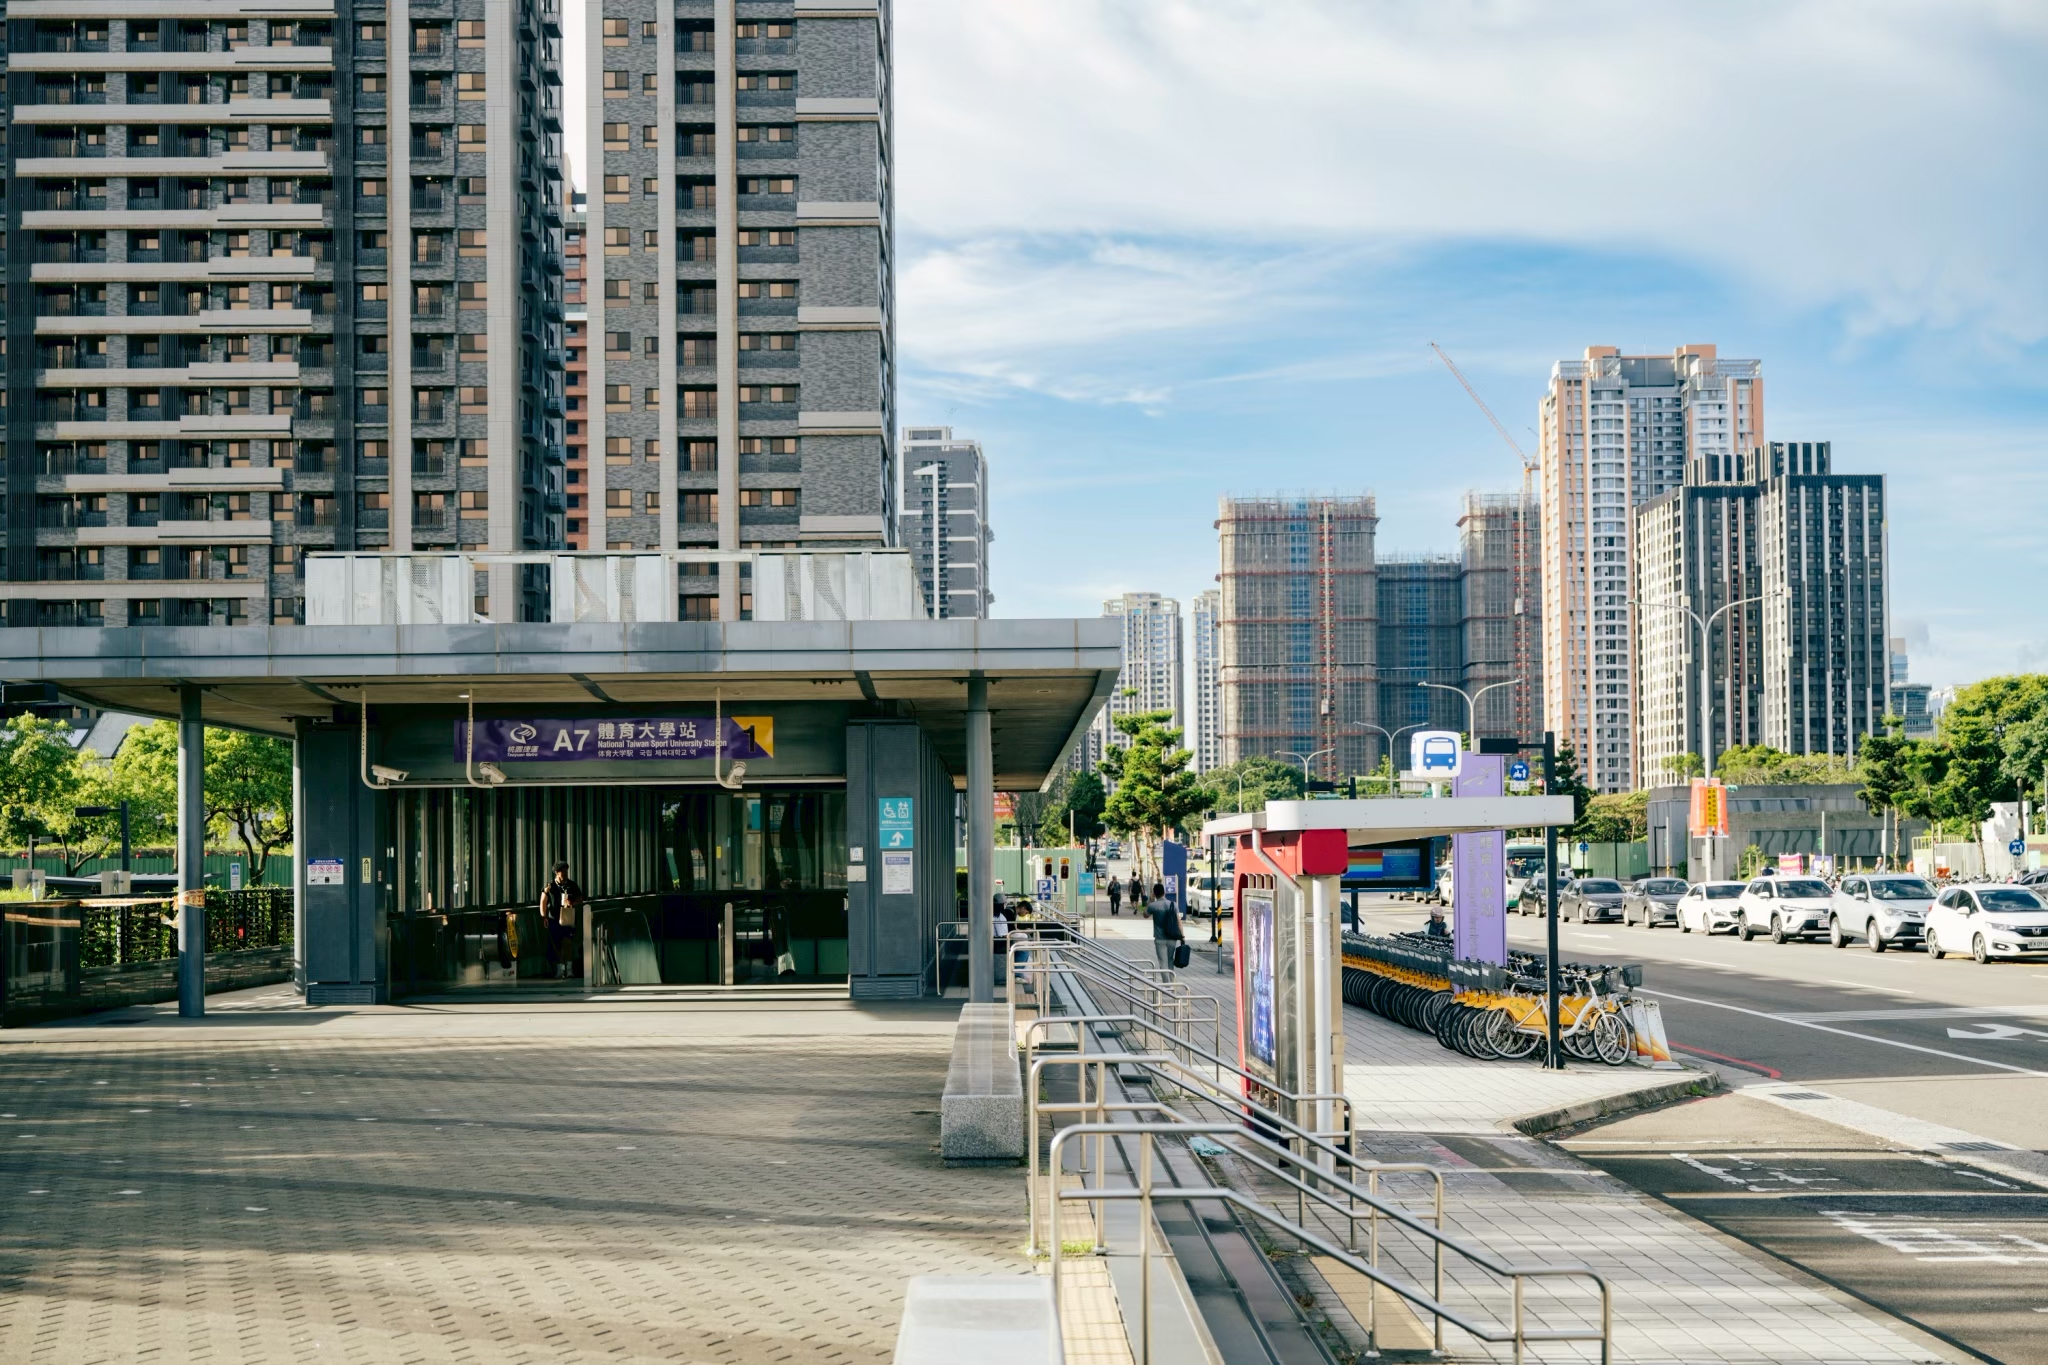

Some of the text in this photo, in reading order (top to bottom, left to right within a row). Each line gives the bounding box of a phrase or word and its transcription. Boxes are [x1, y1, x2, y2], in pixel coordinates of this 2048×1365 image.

[598, 722, 697, 739] 體育大學站
[743, 725, 755, 752] 1
[553, 729, 590, 751] A7
[598, 739, 727, 749] National Taiwan Sport University Staon
[1039, 881, 1048, 893] P
